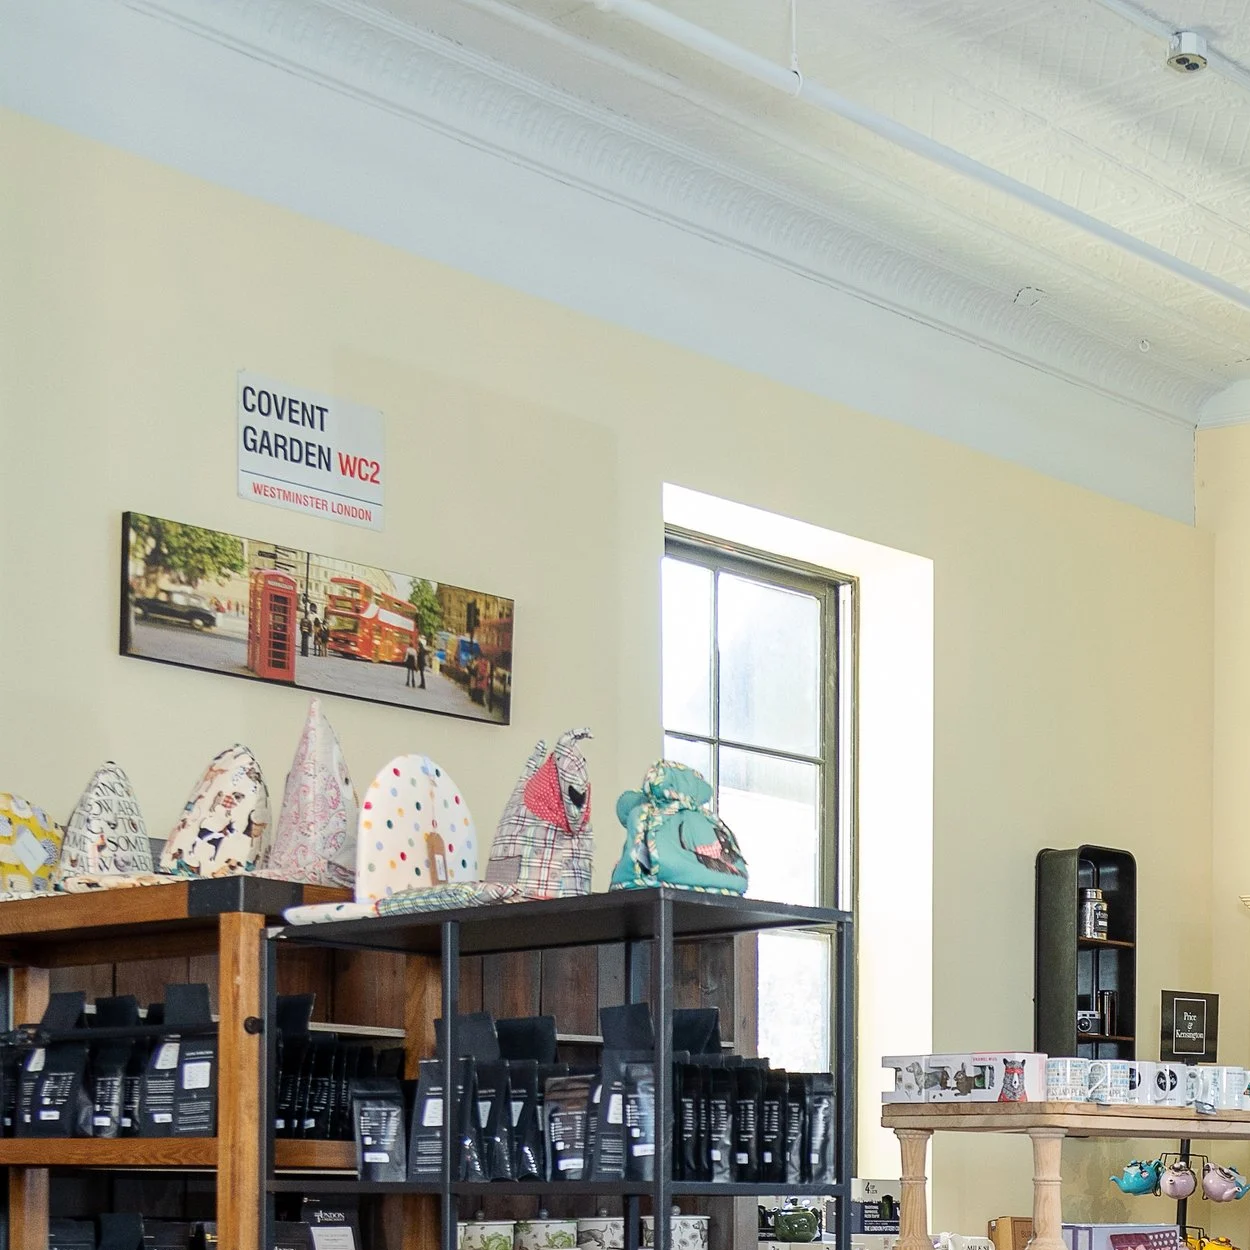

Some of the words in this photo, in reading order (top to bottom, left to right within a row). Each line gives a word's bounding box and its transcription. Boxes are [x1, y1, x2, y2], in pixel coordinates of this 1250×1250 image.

[243, 386, 329, 432] COVENT
[243, 425, 331, 472] GARDEN
[338, 452, 380, 484] WC2
[252, 482, 328, 511] WESTMINSTER
[331, 501, 372, 521] LONDON
[1183, 1011, 1197, 1021] Price
[1175, 1029, 1204, 1041] Kensington
[864, 1182, 869, 1194] 4
